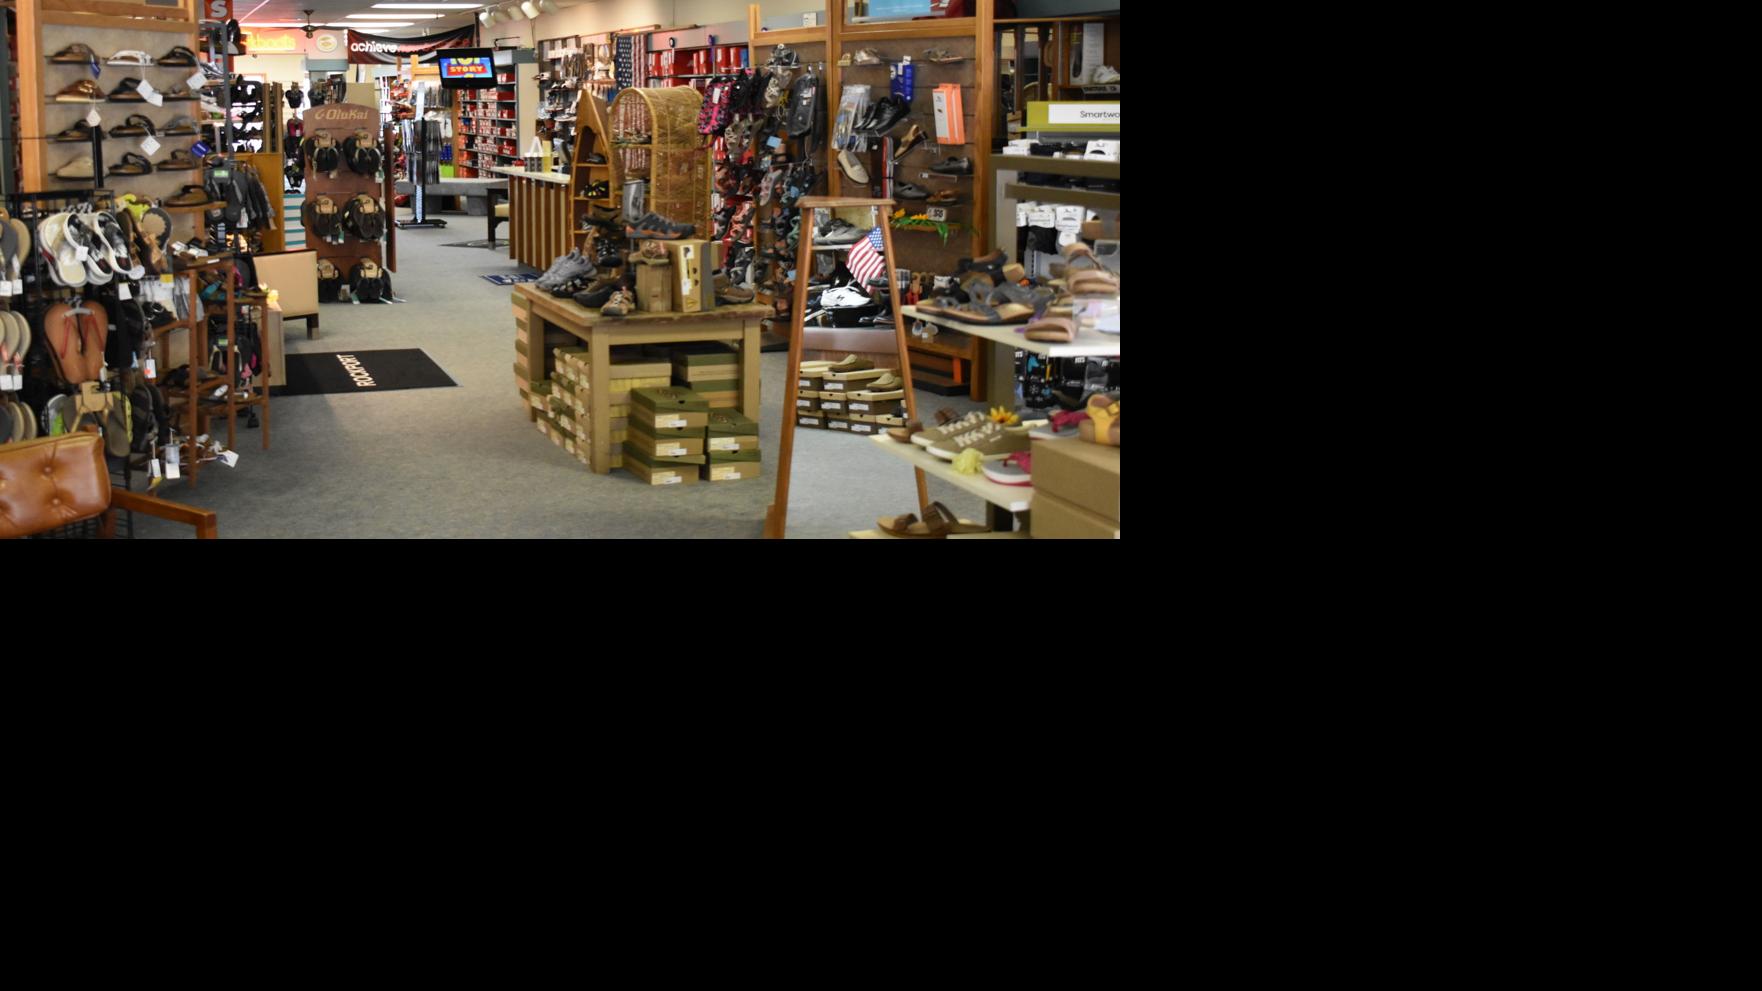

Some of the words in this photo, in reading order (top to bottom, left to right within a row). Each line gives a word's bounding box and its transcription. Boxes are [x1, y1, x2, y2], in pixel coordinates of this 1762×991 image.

[351, 40, 398, 53] achieve
[450, 65, 484, 73] STORY
[326, 109, 369, 120] OluKai
[336, 354, 377, 387] ROCKPORT
